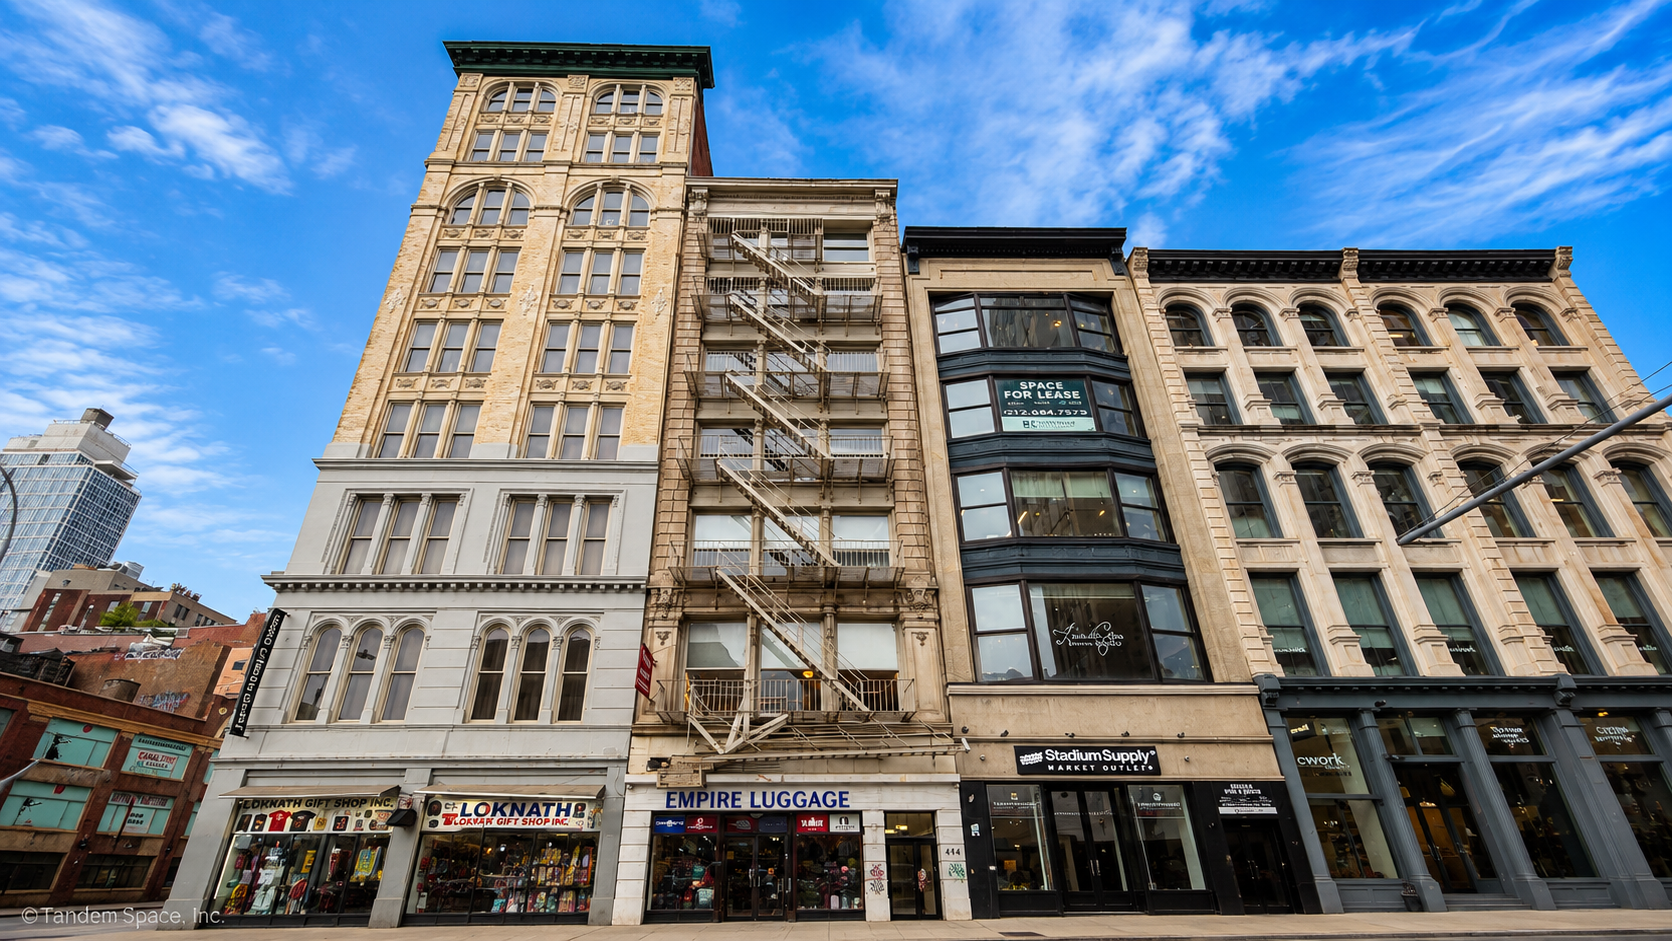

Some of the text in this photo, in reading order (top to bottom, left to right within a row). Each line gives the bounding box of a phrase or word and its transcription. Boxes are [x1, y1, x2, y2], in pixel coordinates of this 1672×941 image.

[1019, 381, 1064, 390] SPACE
[1003, 390, 1081, 399] FOR LEASE
[305, 799, 331, 808] GIFT
[334, 798, 367, 808] SHOP
[370, 797, 394, 807] INC.
[665, 791, 850, 809] EMPIRE LUGGAGE
[460, 802, 572, 817] LOKNATH
[497, 818, 519, 826] GIFT
[522, 818, 550, 826] SHOP
